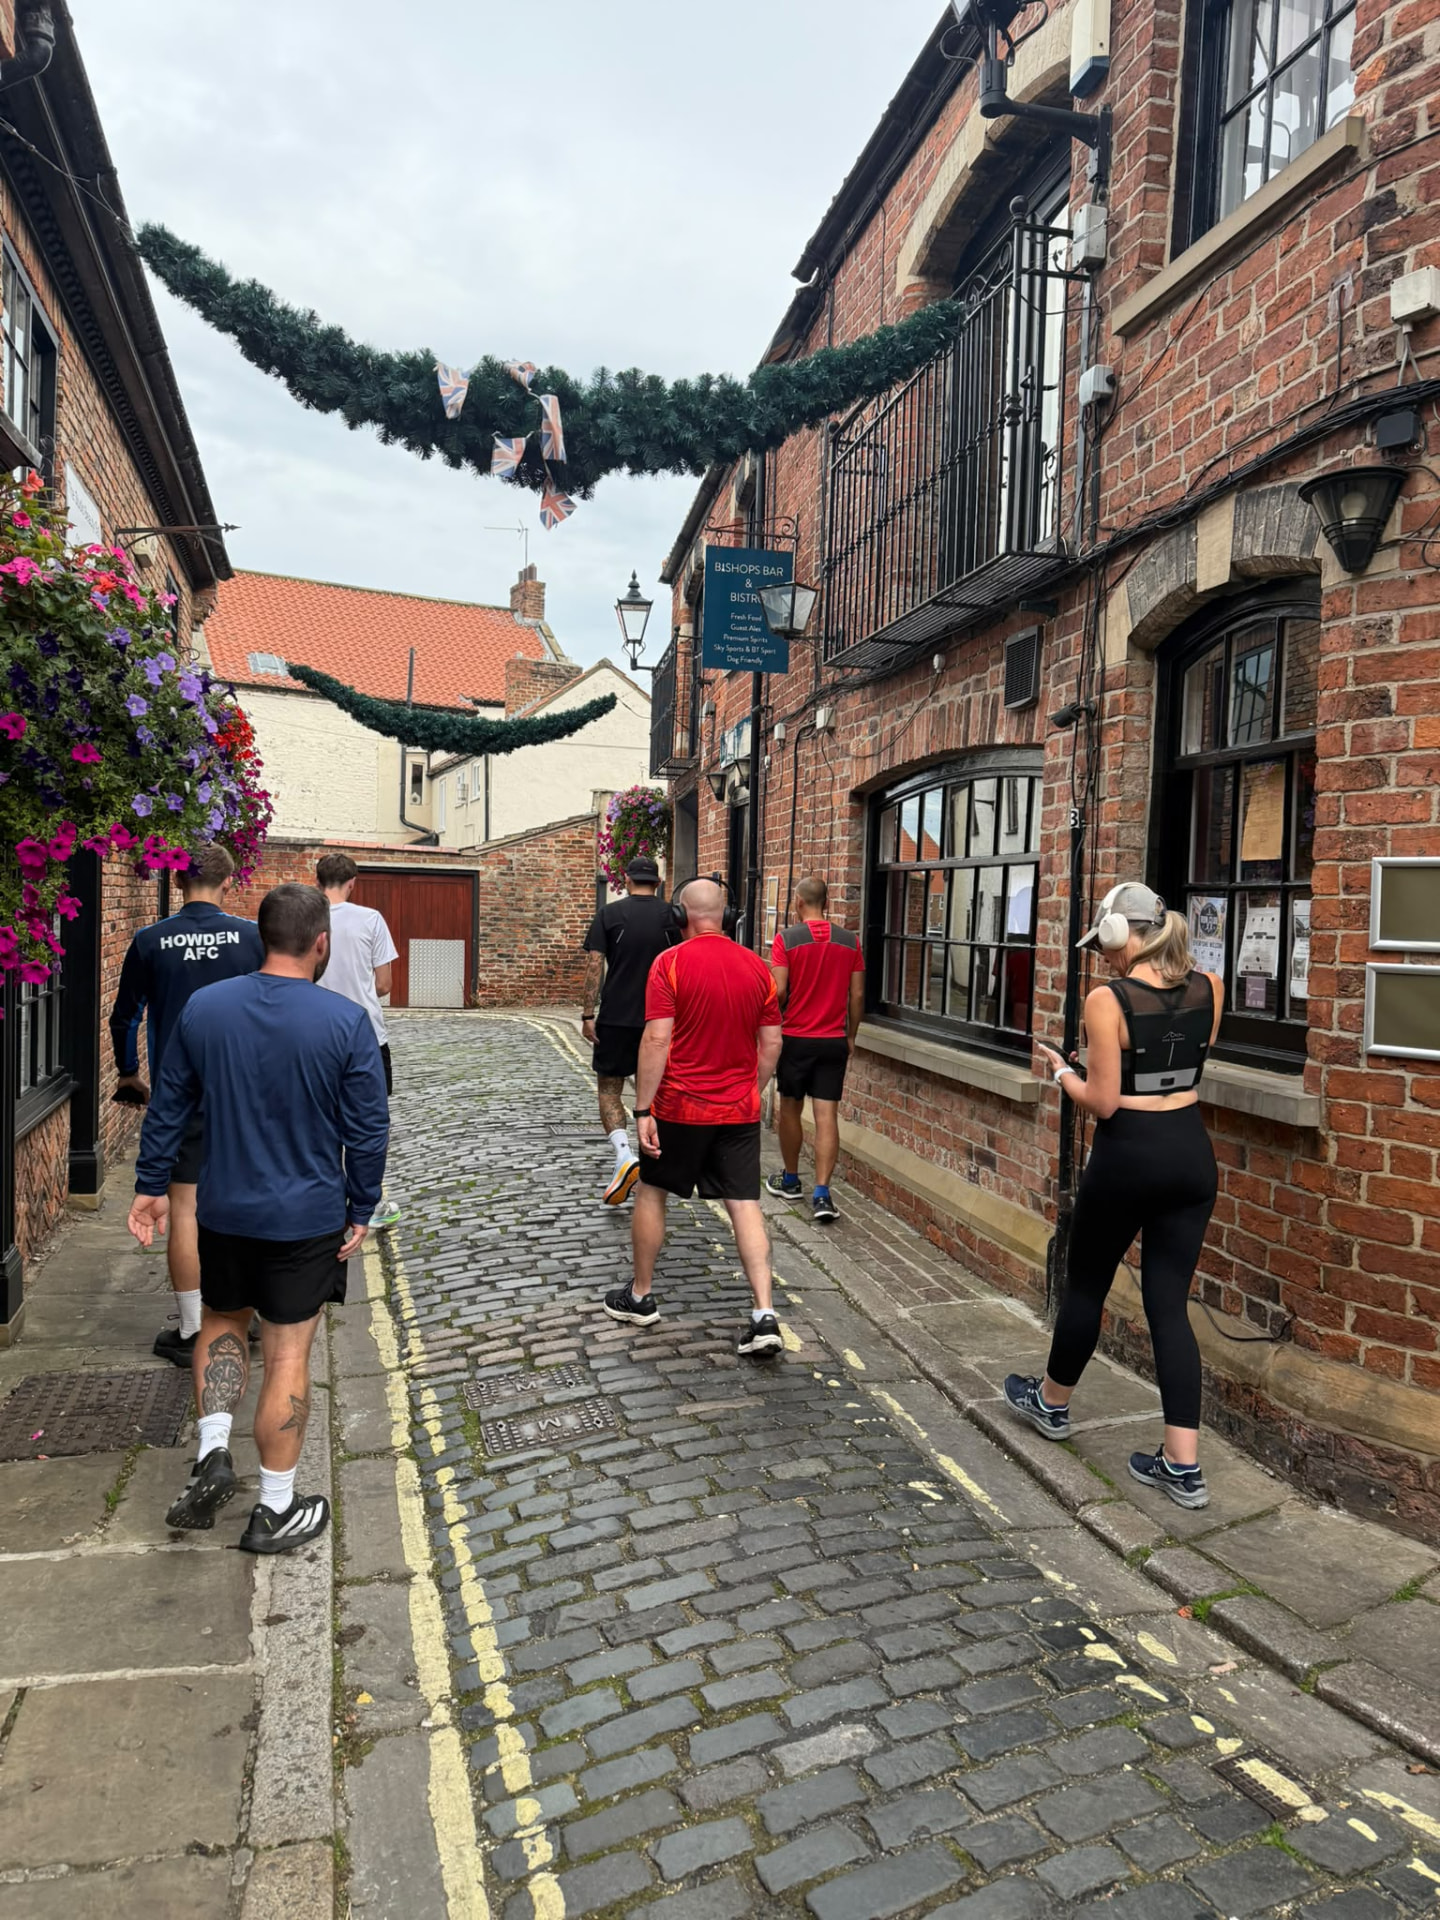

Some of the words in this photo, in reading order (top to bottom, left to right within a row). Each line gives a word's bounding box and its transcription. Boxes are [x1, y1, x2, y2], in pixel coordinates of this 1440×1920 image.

[715, 562, 760, 575] BISHOPS
[763, 566, 783, 577] BAR
[745, 578, 752, 588] &
[731, 592, 761, 603] BISTR
[730, 612, 747, 621] Fresh
[747, 613, 762, 621] Food
[730, 623, 748, 631] Guest
[723, 633, 749, 641] Premium
[750, 635, 768, 644] Spirits
[713, 643, 725, 653] Sky
[745, 645, 750, 653] &
[727, 655, 739, 664] Dog
[740, 656, 763, 665] Friendly
[1070, 810, 1079, 827] 3
[160, 931, 240, 949] HOWDEN
[183, 946, 219, 961] AFC
